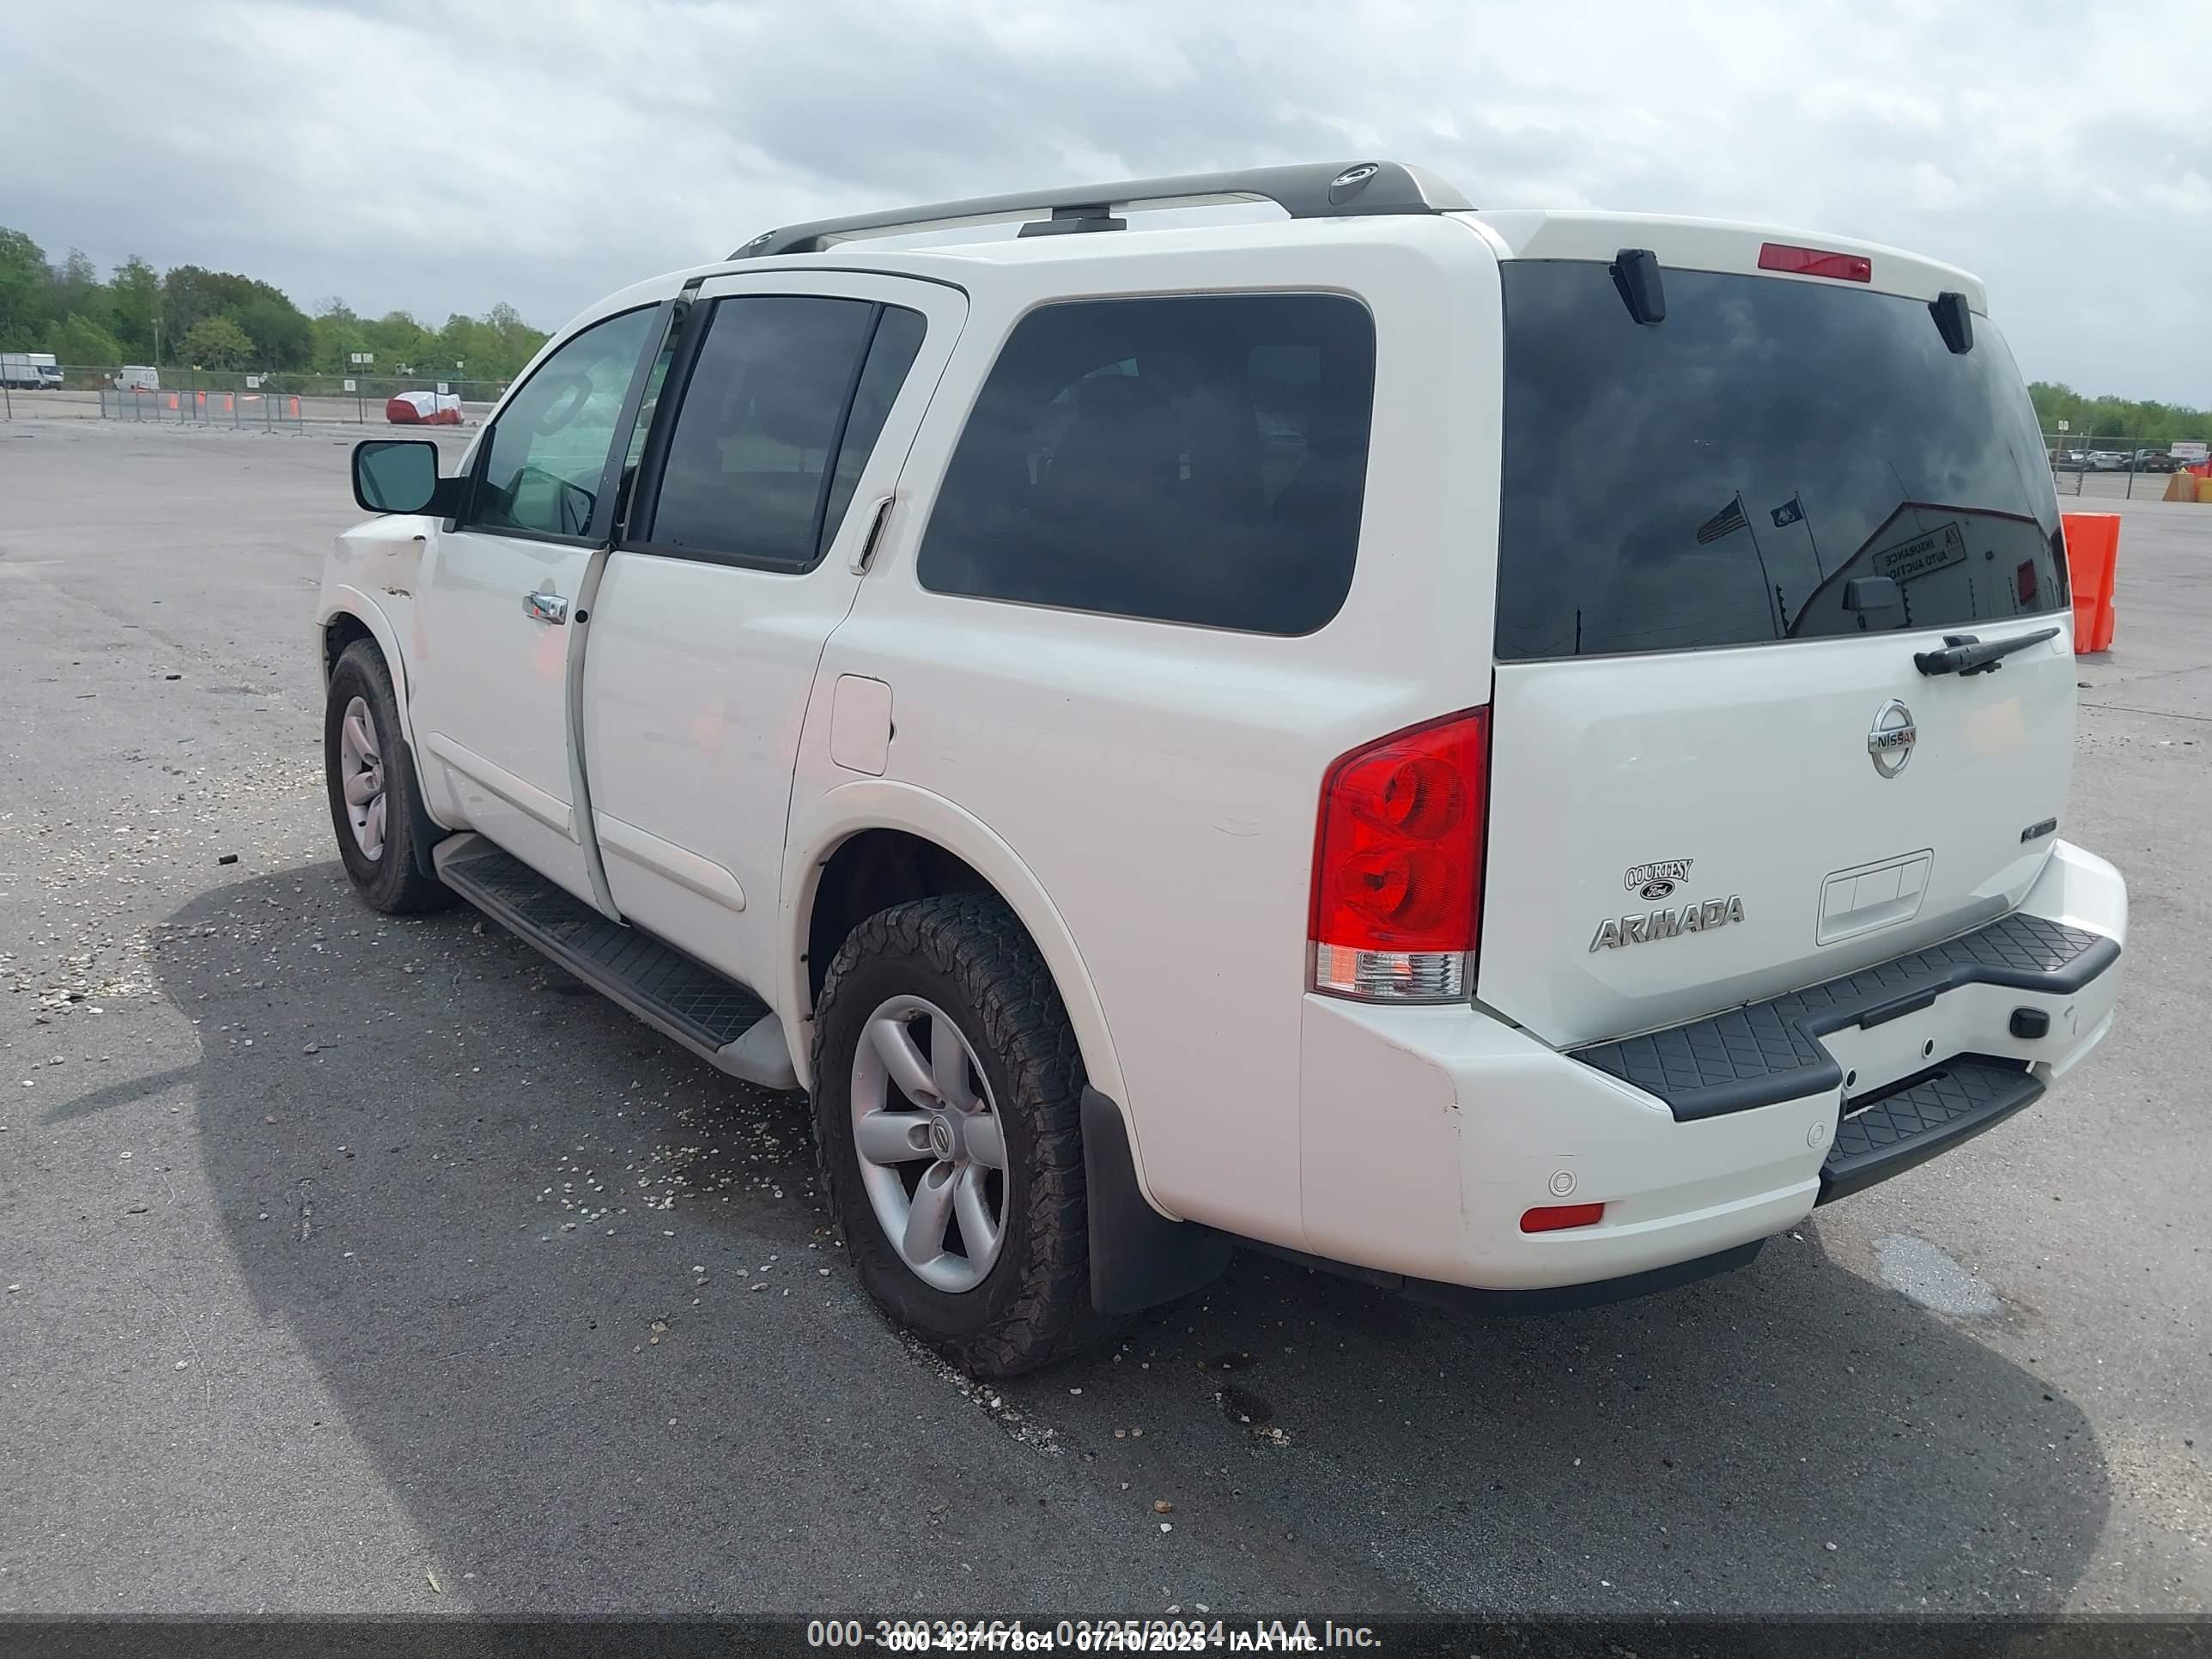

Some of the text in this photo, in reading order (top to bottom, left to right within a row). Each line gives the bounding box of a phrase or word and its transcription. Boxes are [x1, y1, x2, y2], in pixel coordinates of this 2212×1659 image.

[143, 374, 155, 382] 10
[1877, 732, 1916, 749] NISSAN
[1624, 858, 1694, 891] COURTESY
[1646, 884, 1668, 897] Ford
[1589, 894, 1746, 952] ARMADA
